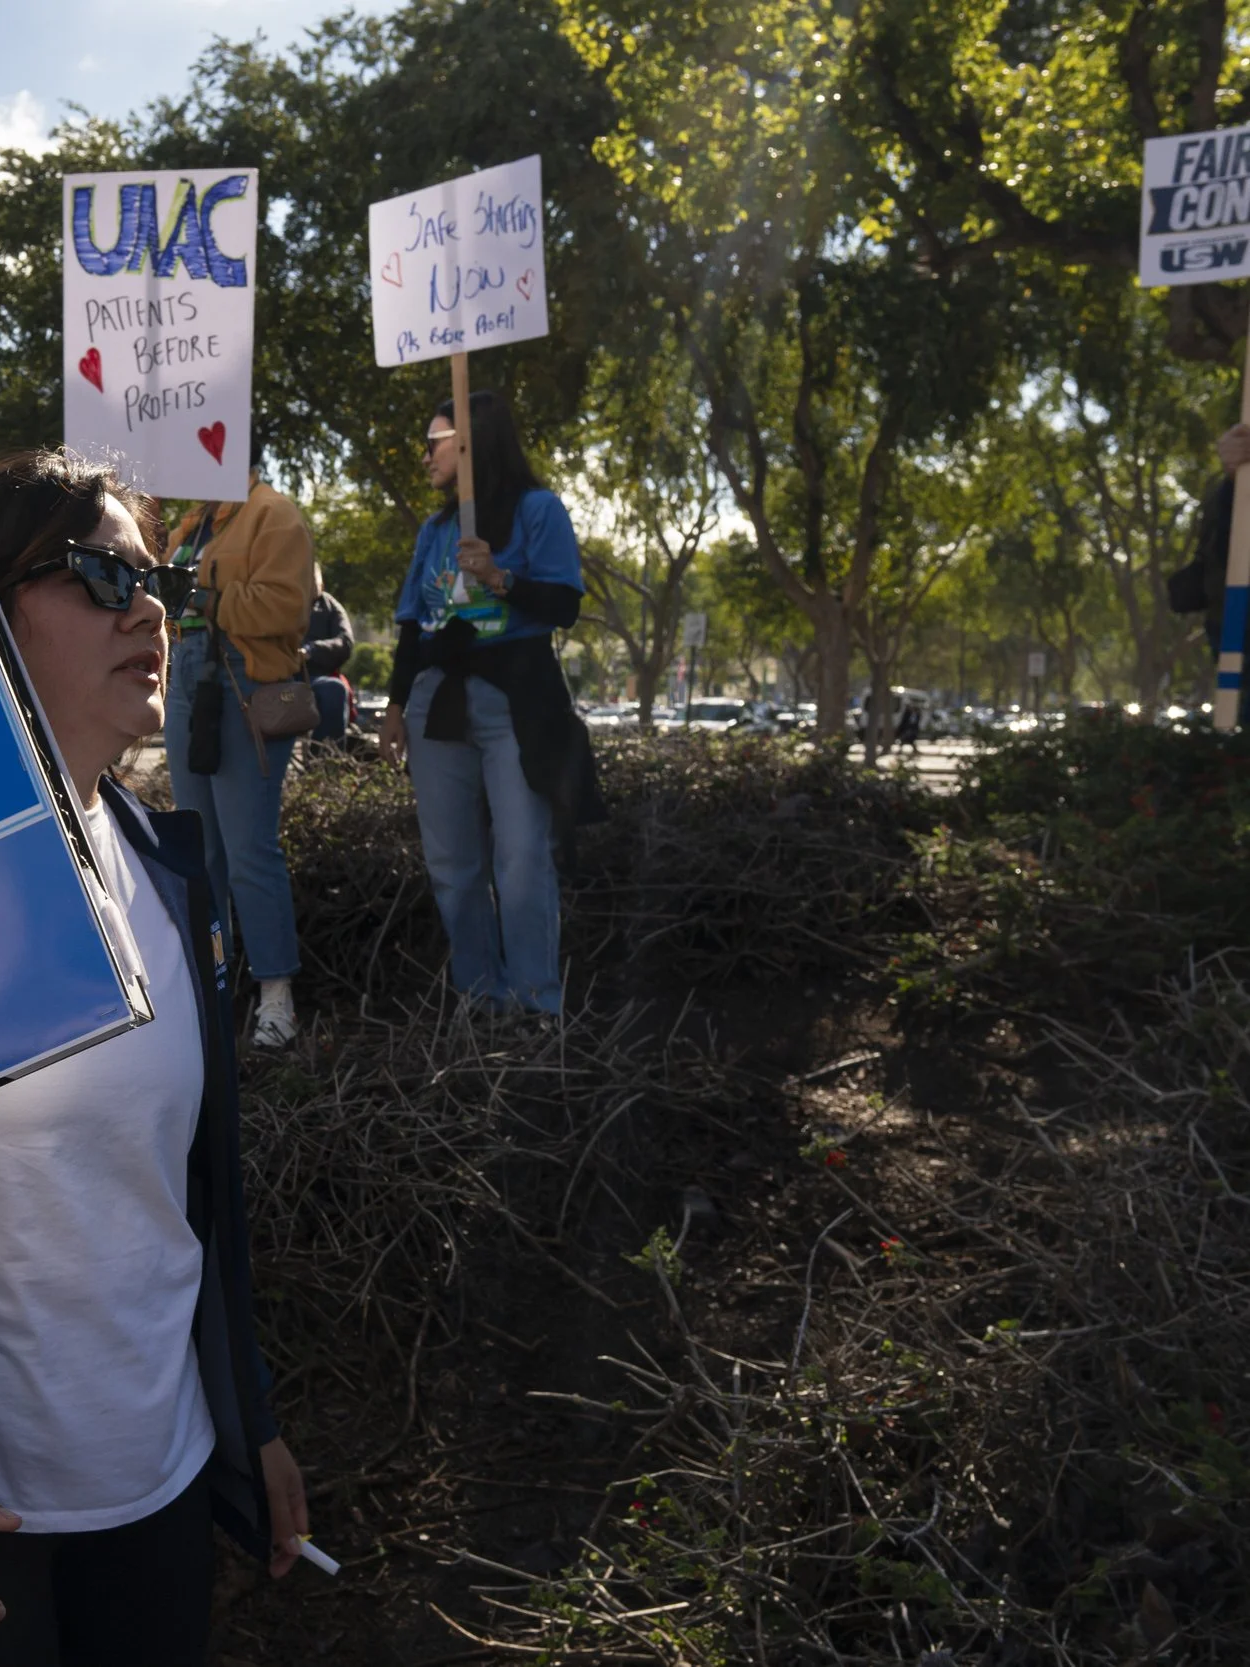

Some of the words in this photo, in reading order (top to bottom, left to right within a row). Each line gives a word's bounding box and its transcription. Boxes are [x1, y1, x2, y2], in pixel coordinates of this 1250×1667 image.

[1160, 239, 1249, 274] USW
[86, 291, 197, 343] PATIENTS
[134, 335, 221, 374] BEFORE
[125, 381, 207, 433] PROFITS
